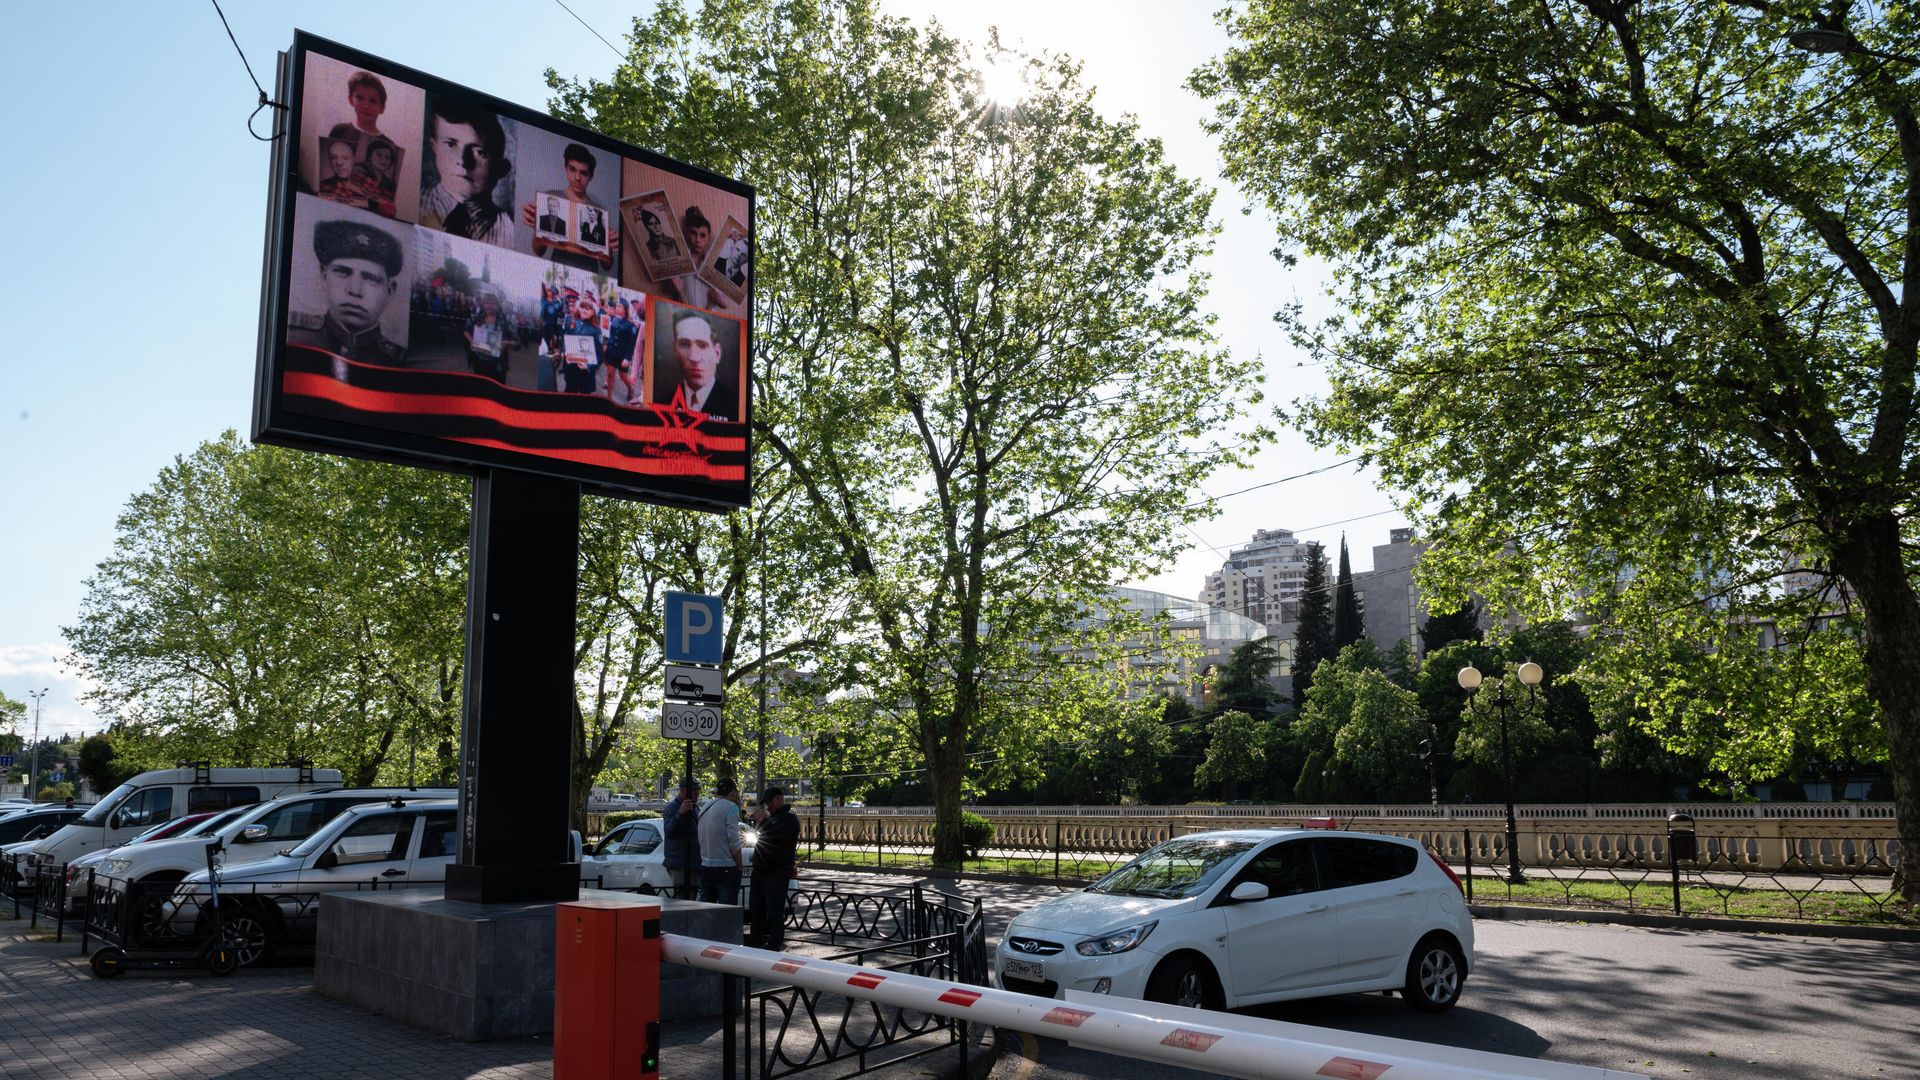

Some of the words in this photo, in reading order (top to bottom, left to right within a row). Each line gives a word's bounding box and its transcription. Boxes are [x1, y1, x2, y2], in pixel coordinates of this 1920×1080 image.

[681, 601, 713, 654] P
[669, 716, 678, 726] 10
[683, 717, 694, 728] 15
[700, 717, 713, 729] 20
